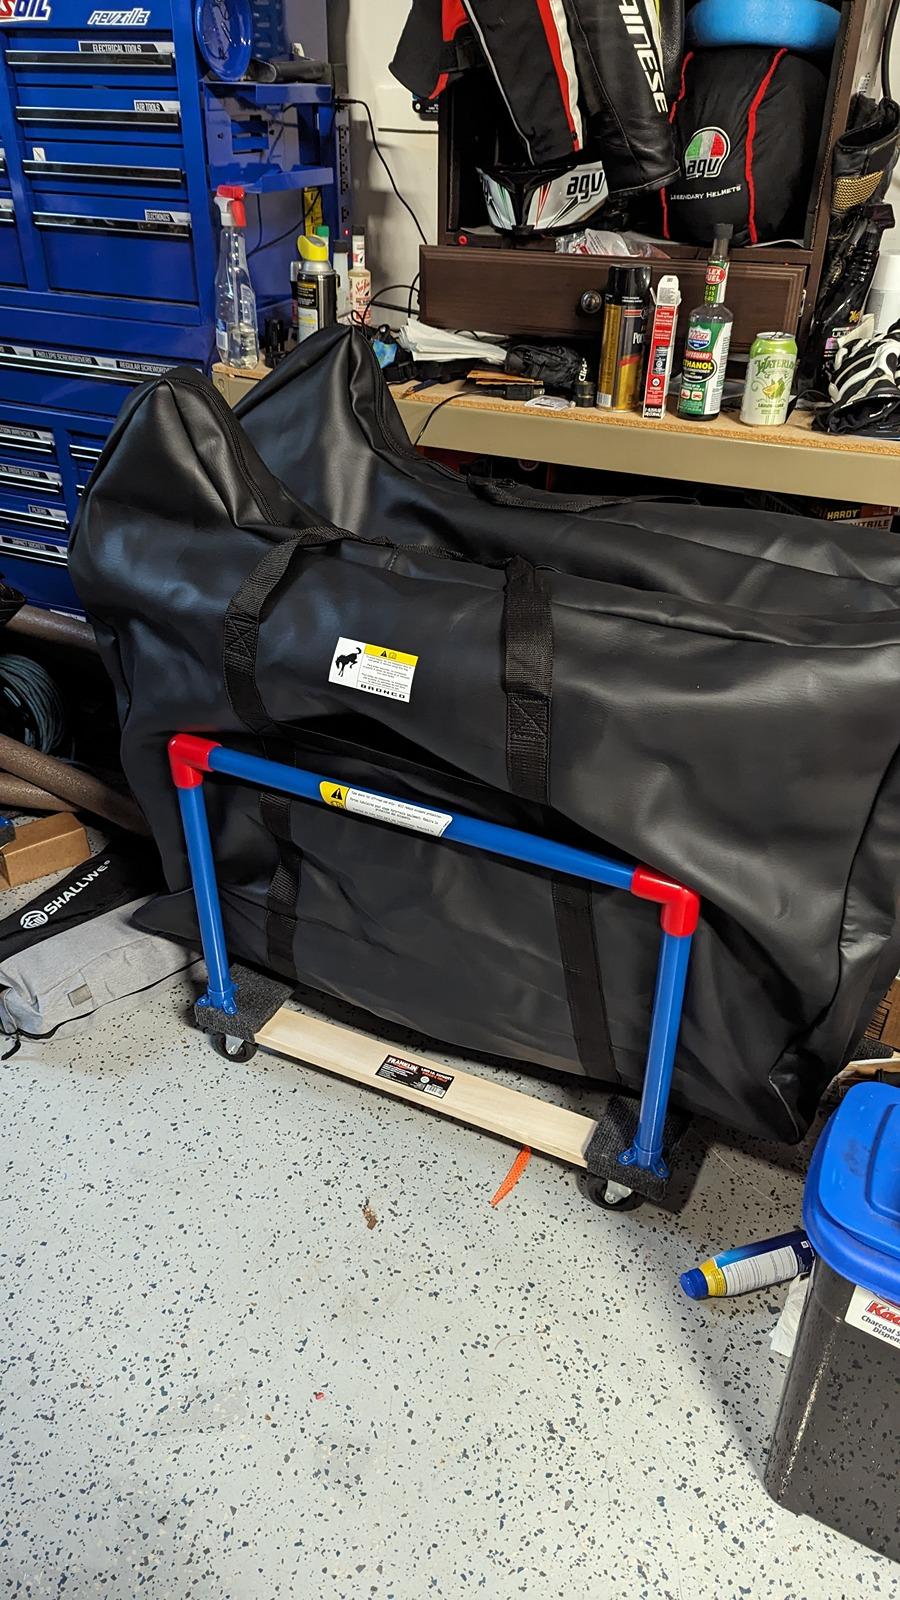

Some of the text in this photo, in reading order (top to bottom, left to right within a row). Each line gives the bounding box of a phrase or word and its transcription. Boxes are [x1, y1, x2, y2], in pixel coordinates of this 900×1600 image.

[89, 9, 150, 25] revzilla
[92, 44, 142, 53] ELECTRICAL TOOLS
[686, 158, 721, 175] agv
[566, 171, 604, 200] agv
[682, 359, 713, 370] ETHANOL
[360, 683, 406, 699] BRONCO
[387, 1057, 417, 1072] FRANKLIN
[861, 1315, 896, 1334] Charcoal
[873, 1327, 900, 1344] Dispen
